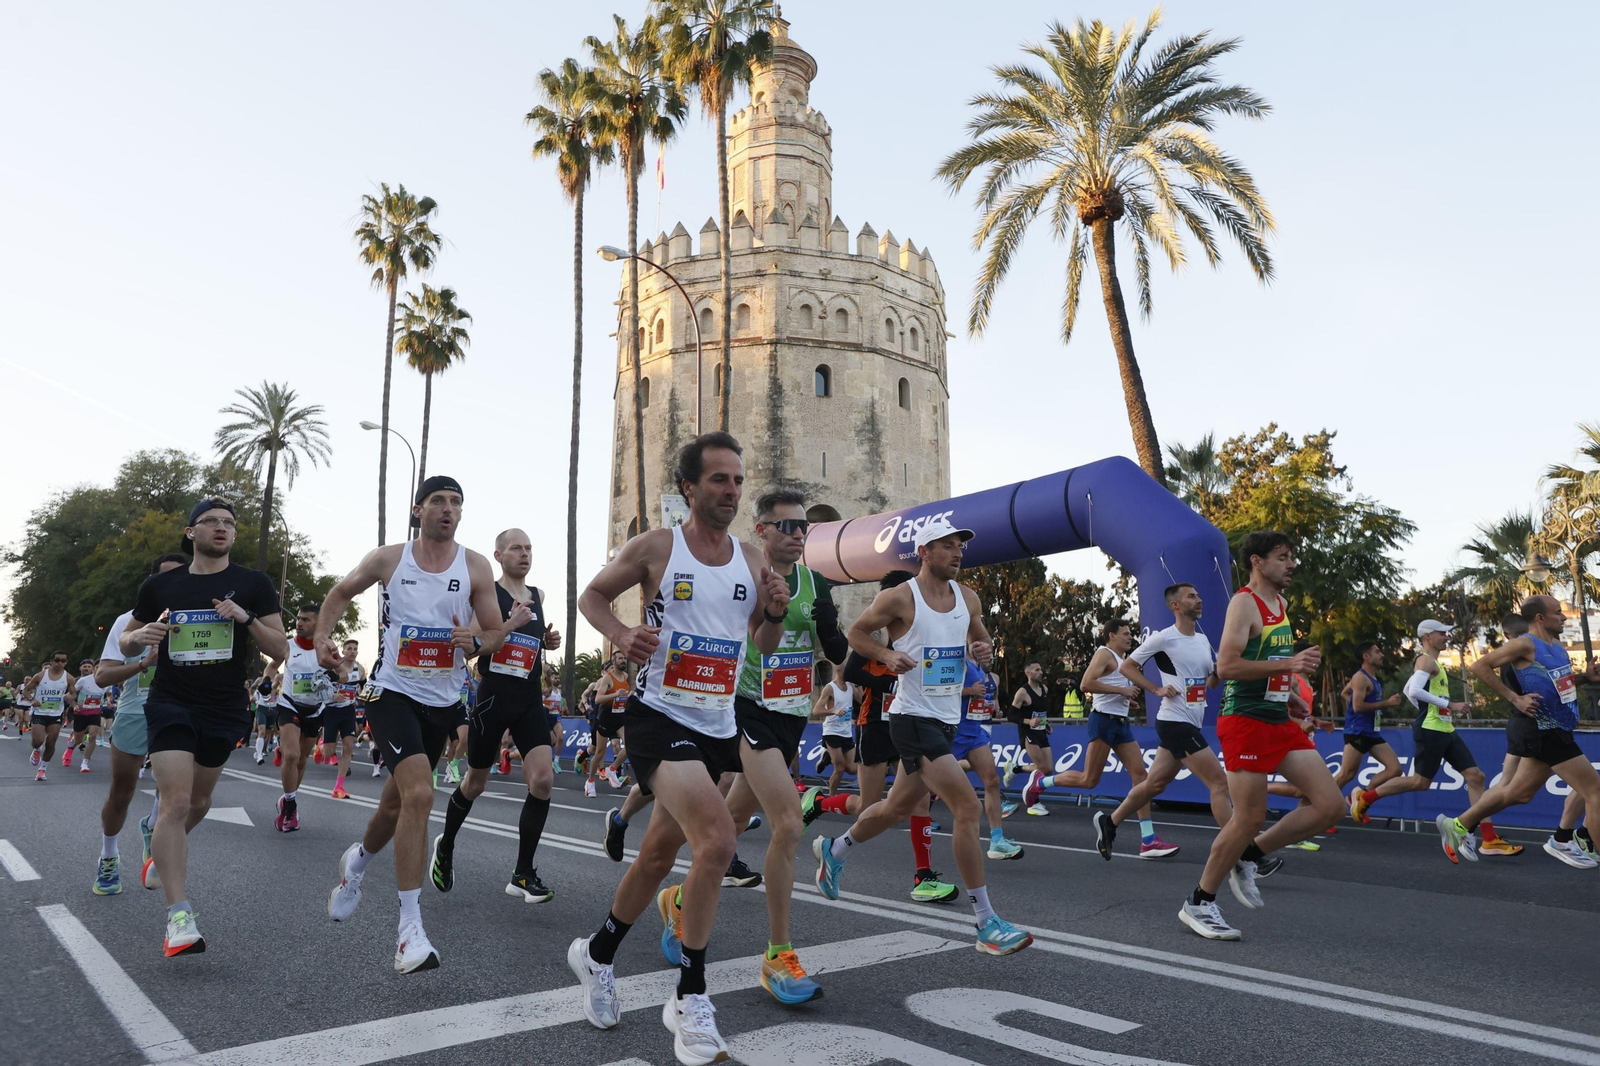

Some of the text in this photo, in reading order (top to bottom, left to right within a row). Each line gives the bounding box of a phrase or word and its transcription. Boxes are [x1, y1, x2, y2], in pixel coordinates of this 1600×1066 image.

[192, 630, 212, 639] 1759
[513, 636, 536, 647] ZURICH
[419, 648, 439, 656] 1000
[697, 641, 735, 655] ZURICH
[511, 650, 523, 658] 640
[418, 659, 437, 667] KADA
[783, 656, 810, 665] ZURICH
[696, 665, 714, 677] 733
[784, 675, 798, 684] 885
[676, 678, 726, 693] BARRUNCHO
[780, 687, 802, 696] ALBERT
